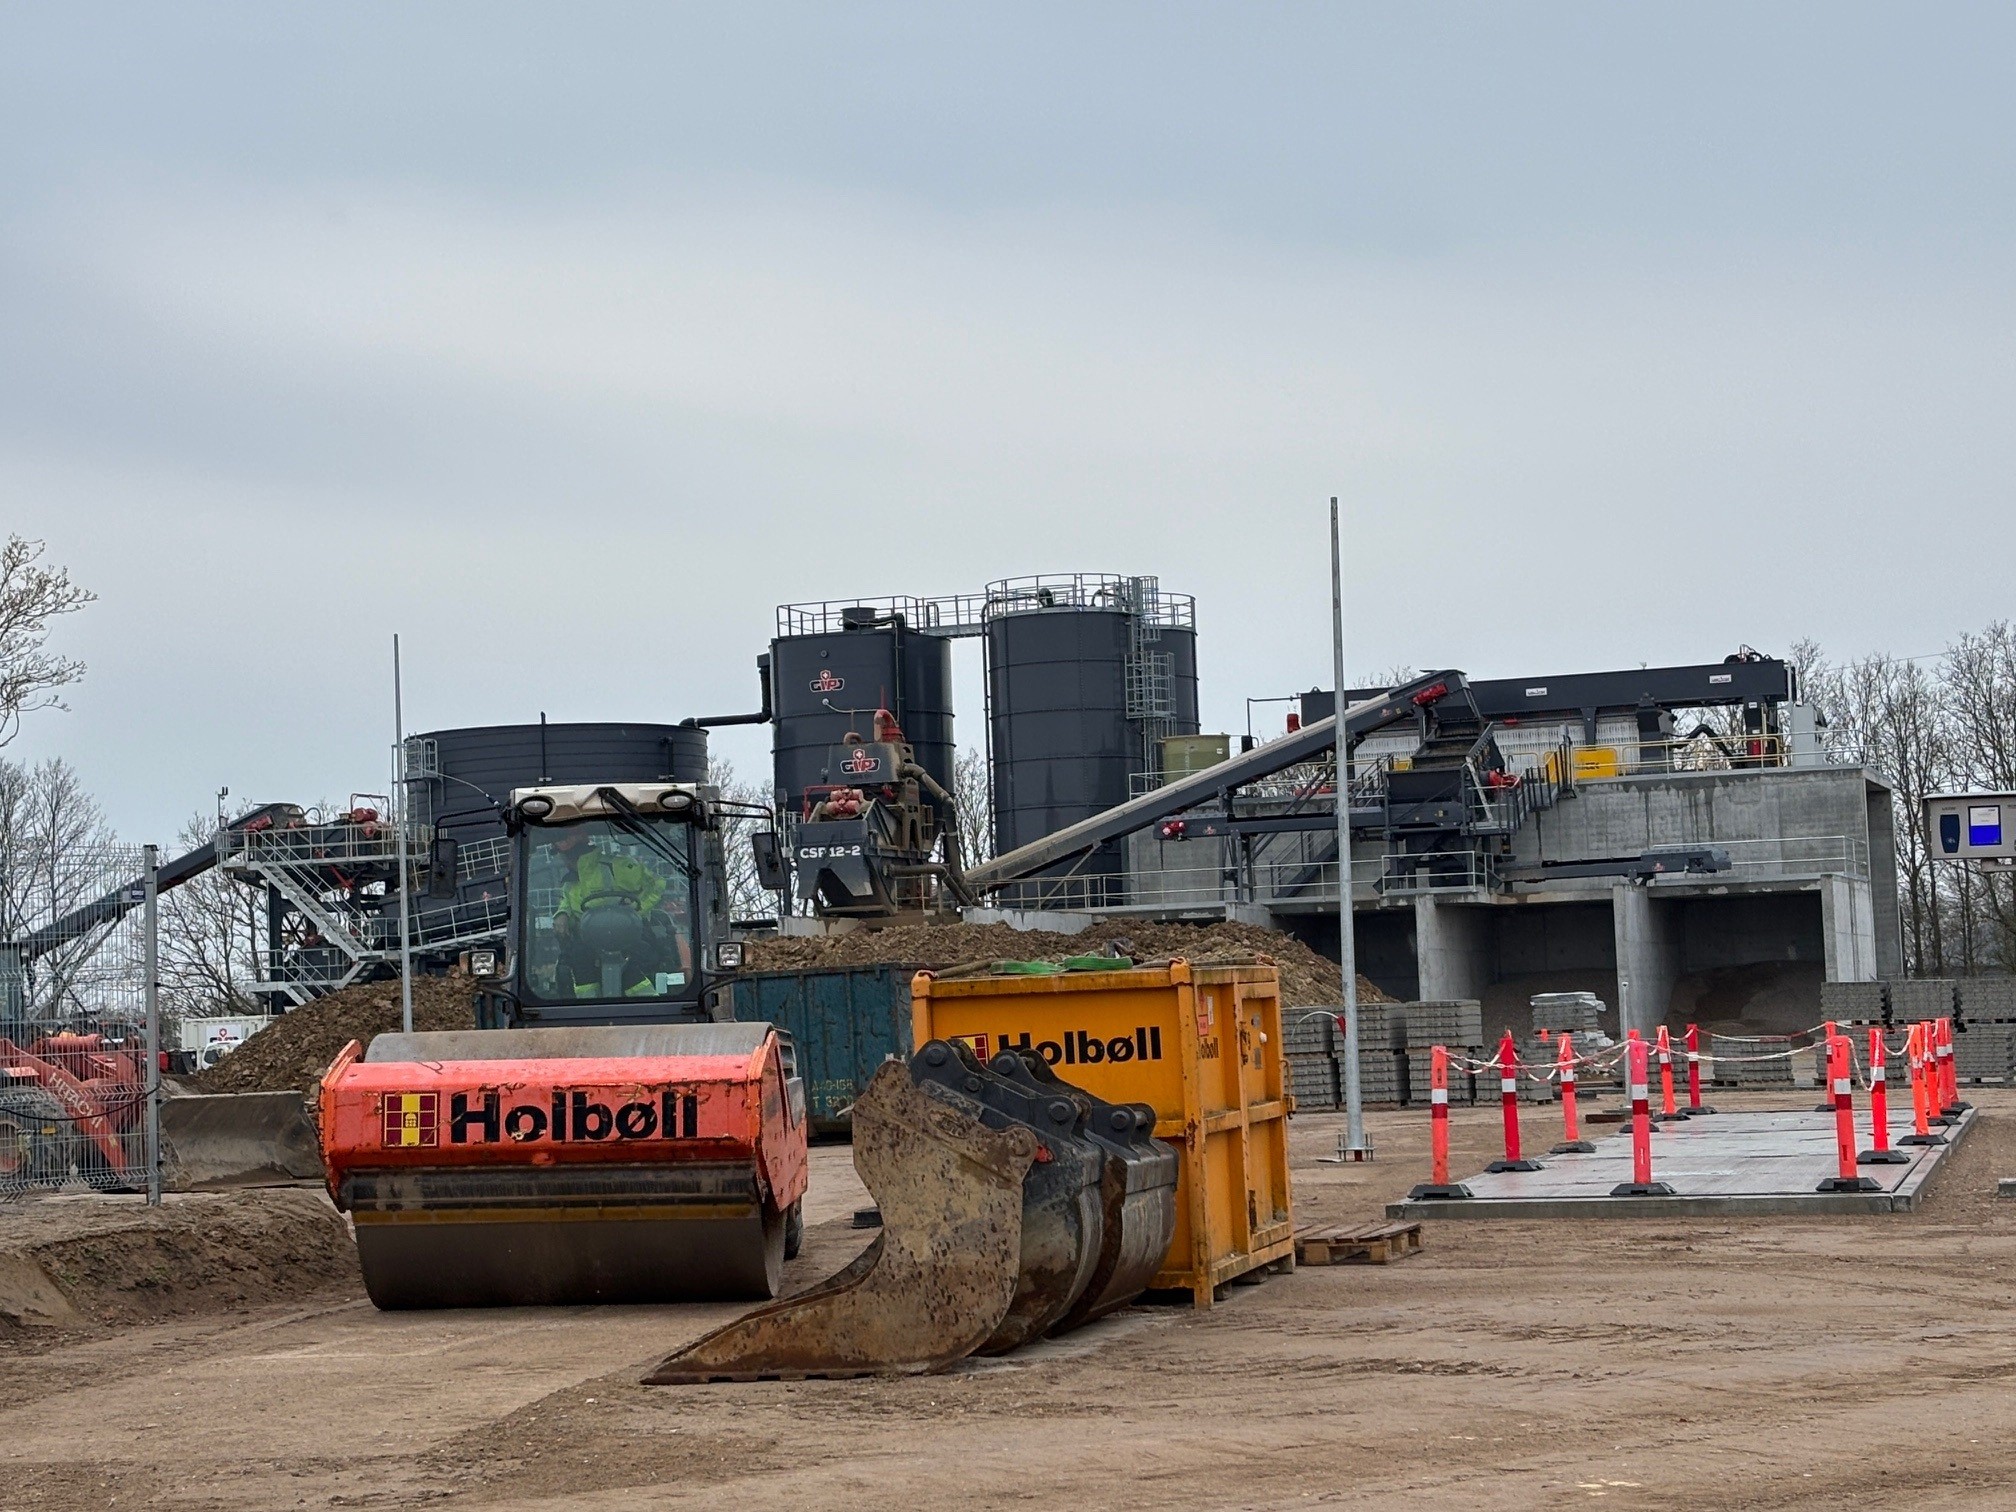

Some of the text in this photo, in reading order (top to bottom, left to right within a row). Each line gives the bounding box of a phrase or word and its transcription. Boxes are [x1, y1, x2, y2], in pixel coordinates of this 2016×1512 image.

[829, 845, 861, 857] 12-2
[997, 1026, 1162, 1066] Holbøll
[450, 1091, 698, 1144] Holbøll
